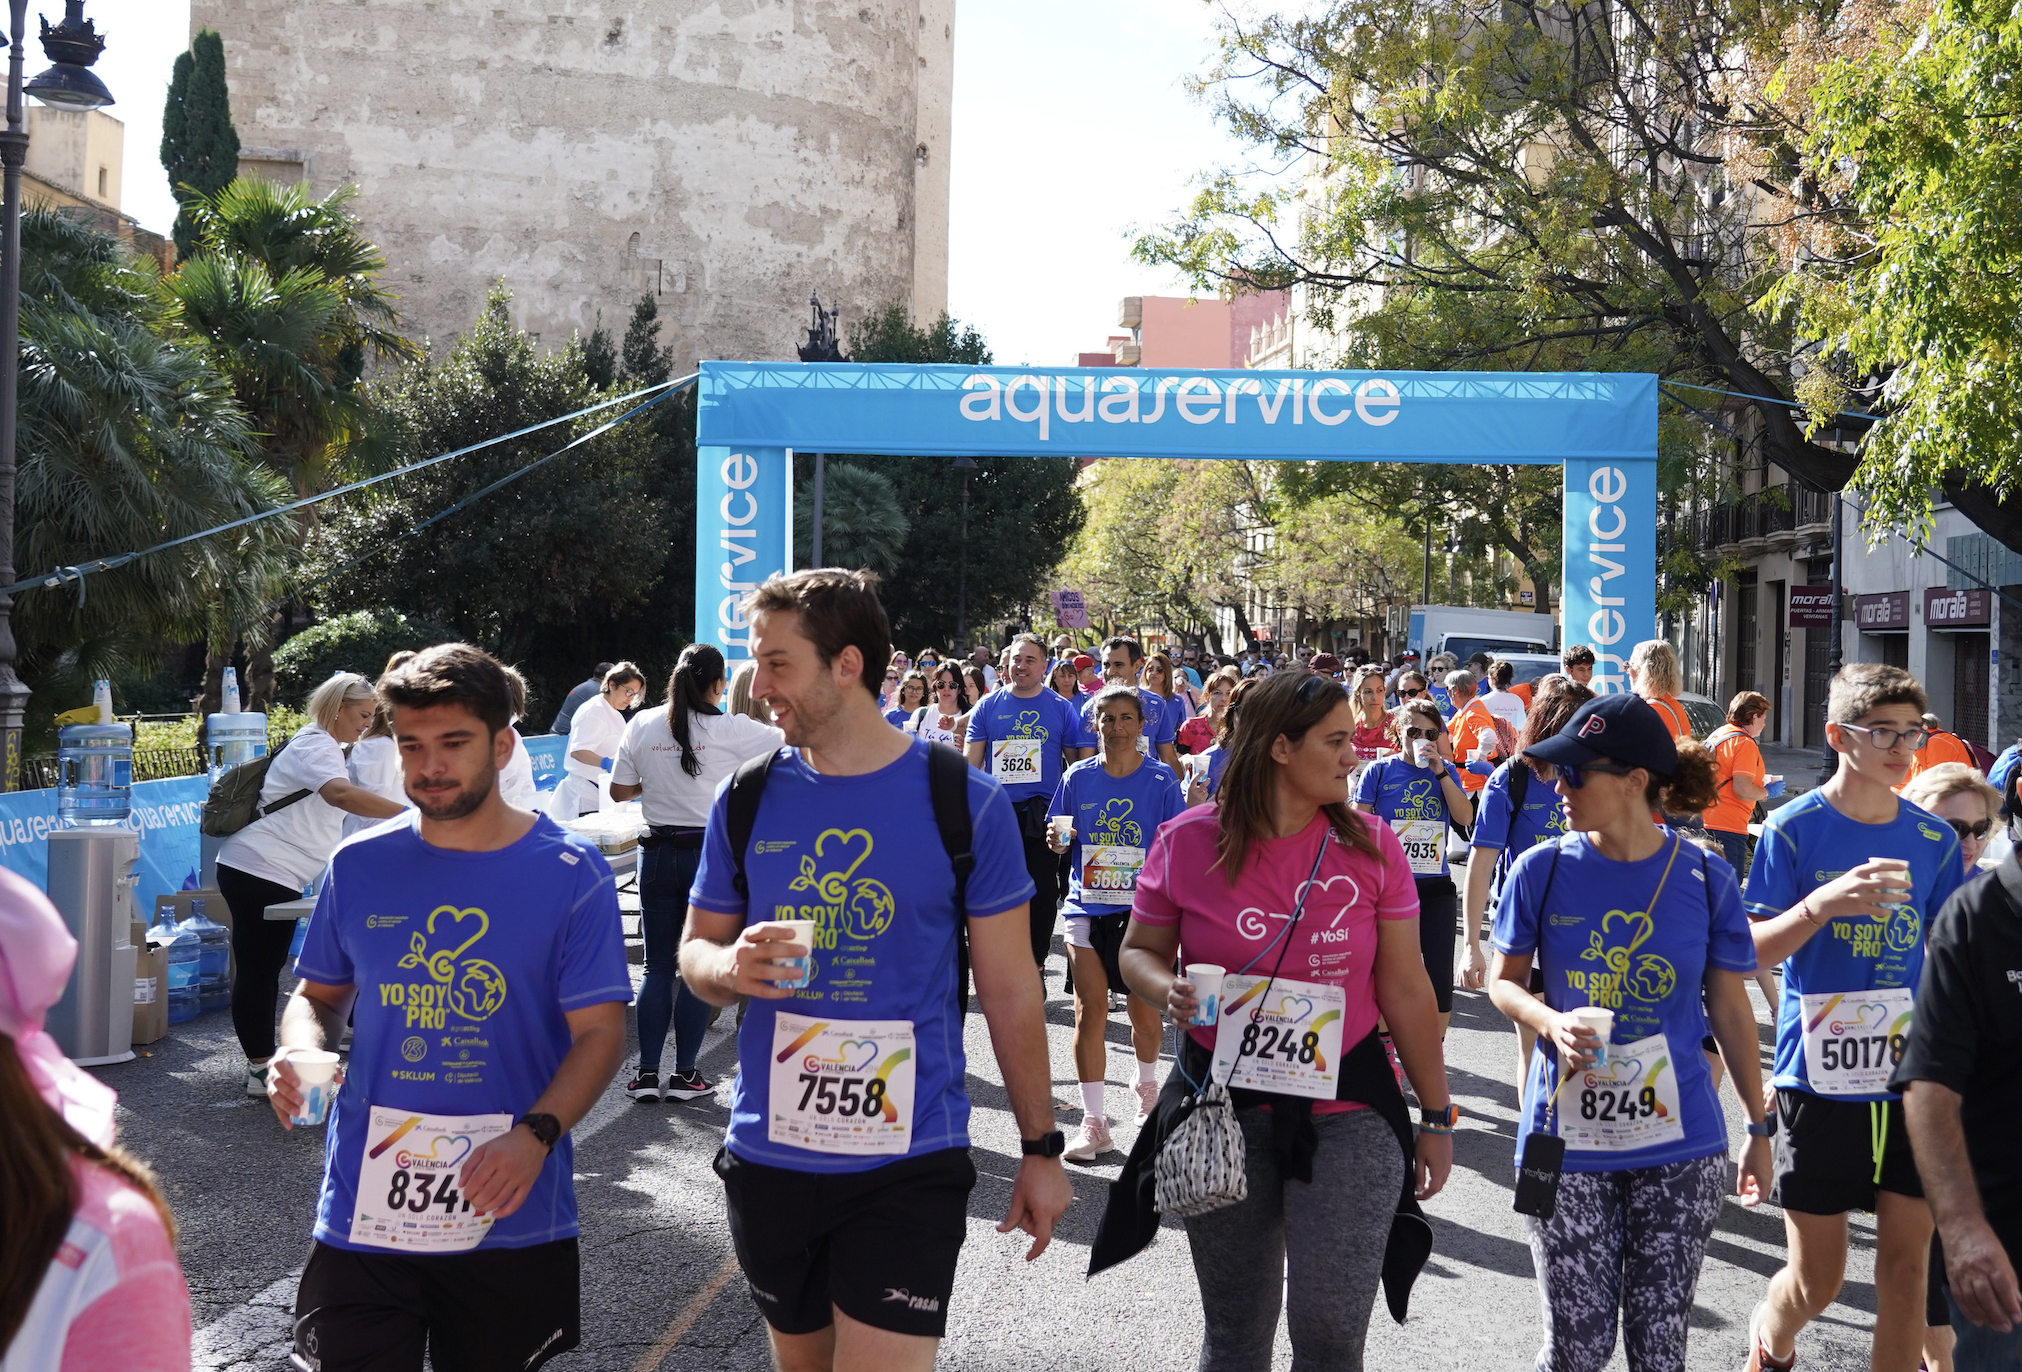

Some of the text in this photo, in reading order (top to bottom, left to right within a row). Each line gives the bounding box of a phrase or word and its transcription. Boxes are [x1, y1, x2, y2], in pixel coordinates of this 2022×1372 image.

[959, 374, 1401, 440] aquaservice
[1578, 714, 1606, 738] P
[1001, 758, 1032, 772] 3626
[1394, 808, 1405, 818] YO
[1406, 808, 1421, 817] SOY
[1089, 833, 1117, 841] YO SOY
[1403, 842, 1437, 859] 7935
[1091, 869, 1133, 890] 3683
[799, 905, 839, 928] SOY
[1832, 922, 1884, 941] YO SOY
[1565, 970, 1622, 991] YO SOY
[379, 983, 447, 1007] YO SOY
[1240, 1023, 1319, 1064] 8248
[1821, 1034, 1905, 1071] 50178
[1276, 1060, 1300, 1069] CORAZÓN
[399, 1070, 436, 1081] SKLUM
[798, 1073, 886, 1117] 7558
[1580, 1086, 1656, 1122] 8249
[837, 1116, 866, 1124] CORAZÓN
